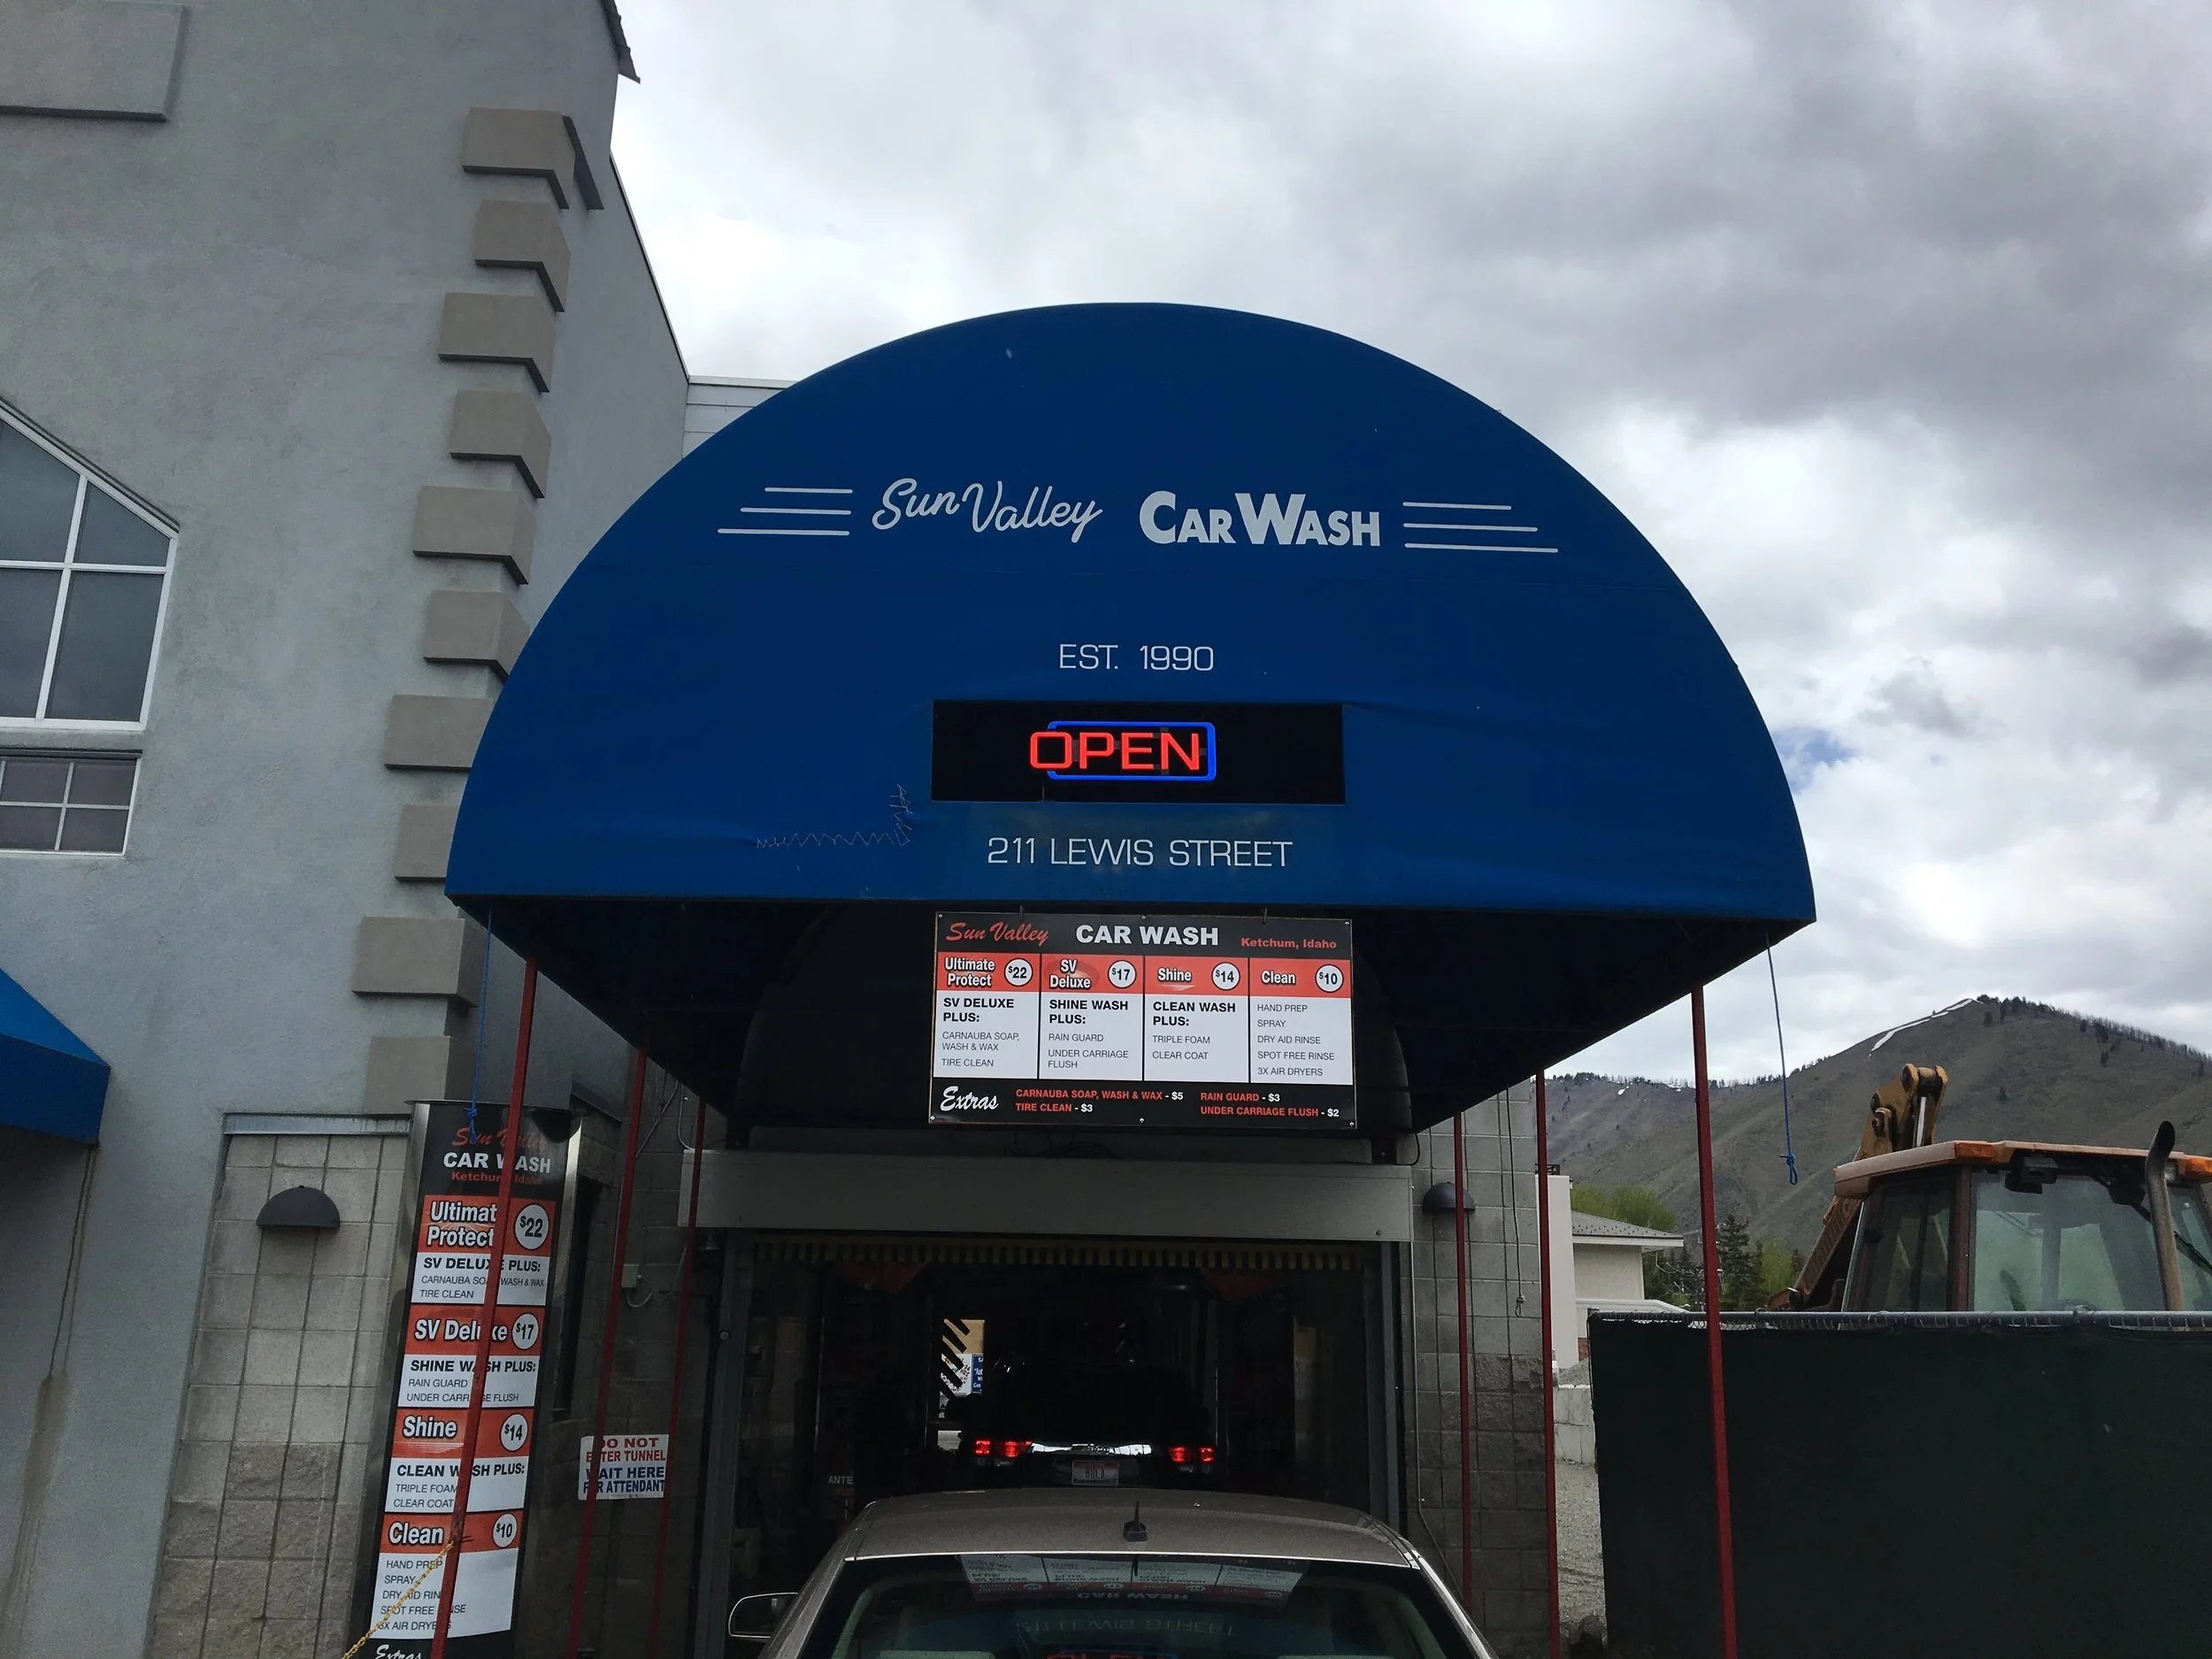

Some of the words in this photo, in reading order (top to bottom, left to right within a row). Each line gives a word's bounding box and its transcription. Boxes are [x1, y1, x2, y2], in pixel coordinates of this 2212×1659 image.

[872, 478, 961, 530] Sun
[961, 480, 1103, 543] Valley
[1139, 490, 1237, 545] CAR
[1234, 492, 1381, 547] WASH
[1059, 643, 1119, 670] EST.
[1140, 645, 1215, 672] 1990
[1029, 731, 1200, 771] OPEN
[987, 836, 1035, 864] 211
[1050, 837, 1155, 865] LEWIS
[1169, 839, 1294, 867] STREET
[945, 921, 987, 941] Sun
[989, 921, 1049, 947] Valley
[1075, 924, 1133, 945] CAR
[1139, 926, 1219, 947] WASH
[1240, 937, 1300, 950] Ketchum,
[1302, 939, 1338, 949] Idaho
[944, 956, 996, 972] Ultimate
[1060, 958, 1079, 972] SV
[1008, 965, 1028, 979] $22
[1111, 967, 1131, 981] $17
[1156, 967, 1193, 982] Shine
[1215, 969, 1235, 983] $14
[1260, 970, 1297, 984] Clean
[947, 972, 993, 987] Protect
[1048, 974, 1092, 989] Deluxe
[1318, 972, 1339, 986] $10
[943, 997, 960, 1009] SV
[964, 998, 1015, 1010] DELUXE
[1048, 999, 1088, 1010] SHINE
[1091, 1000, 1129, 1011] WASH
[1152, 1001, 1195, 1012] CLEAN
[1198, 1002, 1236, 1013] WASH
[1256, 1003, 1283, 1012] HAND
[1284, 1004, 1309, 1013] PREP
[942, 1011, 980, 1023] PLUS:
[1048, 1014, 1087, 1025] PLUS:
[1152, 1016, 1190, 1026] PLUS:
[1256, 1019, 1286, 1028] SPRAY
[941, 1031, 993, 1041] CARNAUBA
[994, 1032, 1020, 1042] SOAP,
[1048, 1033, 1070, 1042] RAIN
[1071, 1033, 1104, 1042] GUARD
[1152, 1035, 1184, 1044] TRIPLE
[1184, 1035, 1211, 1045] FOAM
[1256, 1035, 1276, 1044] DRY
[1277, 1035, 1294, 1045] AID
[1294, 1036, 1322, 1045] RINSE
[941, 1042, 969, 1051] WASH
[971, 1042, 977, 1051] &
[978, 1042, 1000, 1052] WAX
[1048, 1048, 1080, 1058] UNDER
[1082, 1049, 1129, 1059] CARRIAGE
[1152, 1050, 1183, 1060] CLEAR
[1184, 1050, 1210, 1060] COAT
[1256, 1050, 1282, 1060] SPOT
[1283, 1051, 1307, 1061] FREE
[1308, 1052, 1335, 1062] RINSE
[941, 1058, 962, 1067] TIRE
[963, 1058, 995, 1068] CLEAN
[1047, 1060, 1079, 1069] FLUSH
[1256, 1066, 1270, 1076] 3X
[1270, 1067, 1286, 1076] AIR
[1287, 1067, 1324, 1077] DRYERS
[940, 1085, 1000, 1112] Extras
[1015, 1089, 1069, 1099] CARNAUBA
[1071, 1089, 1099, 1101] SOAP,
[1102, 1090, 1130, 1100] WASH
[1132, 1091, 1139, 1100] &
[1141, 1091, 1164, 1101] WAX
[1171, 1090, 1184, 1102] $5
[1200, 1092, 1224, 1102] RAIN
[1225, 1092, 1260, 1102] GUARD
[1268, 1093, 1281, 1103] $3
[1015, 1102, 1038, 1112] TIRE
[1040, 1102, 1072, 1113] CLEAN
[1080, 1102, 1094, 1113] $3
[1200, 1106, 1234, 1116] UNDER
[1236, 1106, 1286, 1117] CARRIAGE
[1287, 1107, 1319, 1118] FLUSH
[1327, 1108, 1340, 1118] $2
[443, 1152, 489, 1169] CAR
[451, 1171, 500, 1182] Ketchu
[430, 1200, 498, 1223] Ultimat
[519, 1215, 543, 1239] $22
[426, 1225, 495, 1248] Protect
[423, 1257, 442, 1270] SV
[508, 1260, 541, 1272] PLUS:
[421, 1275, 471, 1285] CARNAUBA
[500, 1278, 524, 1287] WASH
[530, 1279, 545, 1287] WAX
[419, 1289, 440, 1299] TIRE
[442, 1290, 474, 1299] CLEAN
[414, 1318, 441, 1340] SV
[515, 1322, 534, 1340] $17
[410, 1360, 455, 1372] SHINE
[459, 1360, 501, 1372] WSH
[504, 1361, 536, 1373] PLUS:
[408, 1379, 431, 1387] RAIN
[432, 1379, 468, 1388] GUARD
[406, 1393, 440, 1402] UNDER
[442, 1394, 492, 1402] CARRGE
[493, 1394, 519, 1402] FLUSH
[403, 1415, 458, 1438] Shine
[503, 1424, 524, 1441] $14
[624, 1437, 659, 1448] NOT
[586, 1450, 621, 1463] ETER
[625, 1449, 666, 1462] TUNNEL
[396, 1464, 445, 1477] CLEAN
[449, 1464, 490, 1477] WSH
[493, 1463, 526, 1476] PLUS:
[586, 1467, 623, 1480] AIT
[626, 1466, 665, 1479] HERE
[396, 1483, 427, 1493] TRIPLE
[429, 1484, 457, 1494] FOAM
[583, 1480, 603, 1494] FR
[606, 1479, 665, 1494] ATTENDANT
[393, 1498, 425, 1508] CLEAR
[426, 1499, 455, 1508] COAT
[388, 1521, 444, 1545] Clean
[495, 1523, 513, 1539] $10
[386, 1560, 413, 1570] HAND
[415, 1560, 443, 1570] PREP
[384, 1575, 417, 1585] SPRAY
[382, 1590, 402, 1600] DRY
[423, 1590, 441, 1600] RIN
[408, 1606, 434, 1616] FREE
[392, 1621, 409, 1631] AIR
[411, 1621, 452, 1631] DRYES
